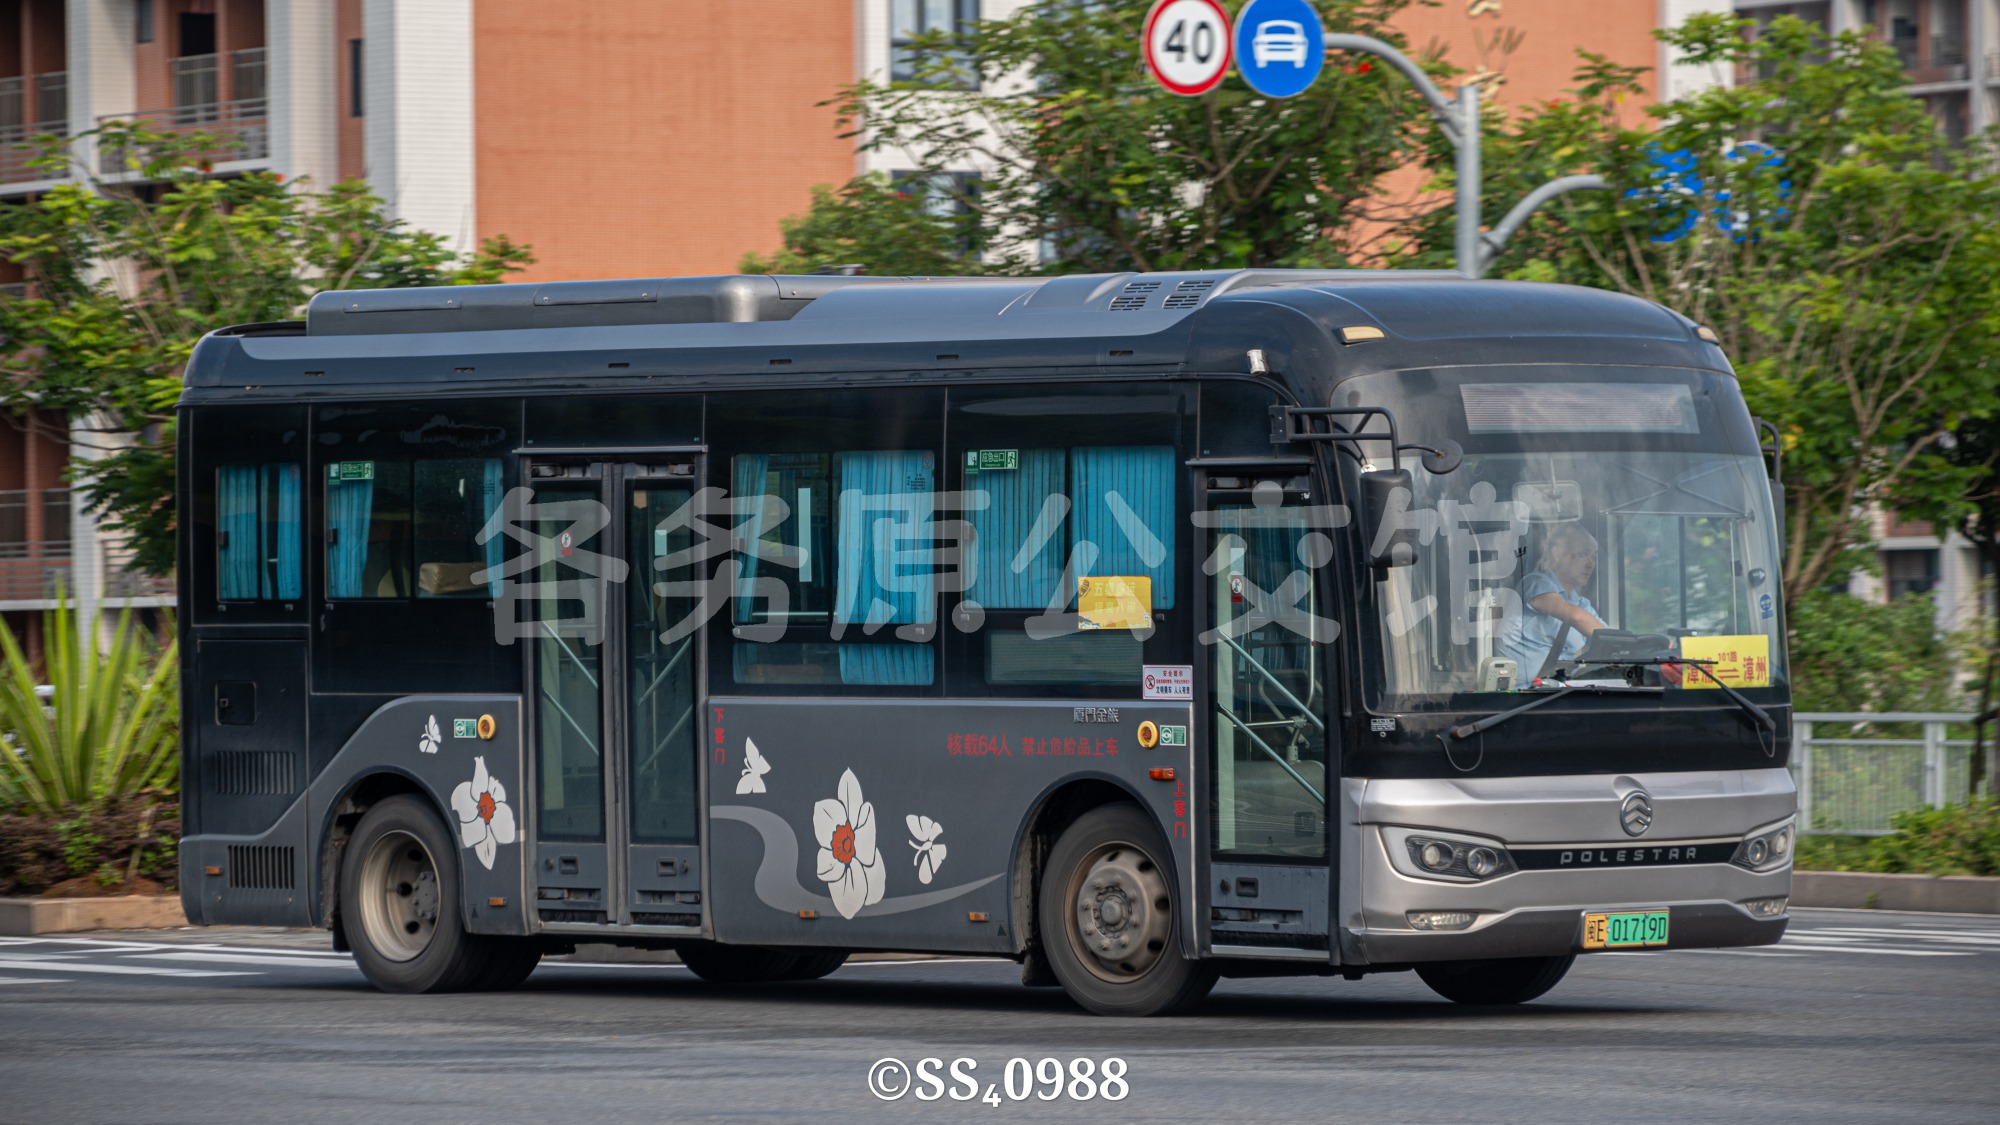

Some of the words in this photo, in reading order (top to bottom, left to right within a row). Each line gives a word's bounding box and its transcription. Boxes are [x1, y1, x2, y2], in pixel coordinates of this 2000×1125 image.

[1163, 19, 1215, 64] 40
[713, 708, 725, 766] 下客门
[947, 732, 1012, 757] 核载64人
[1022, 736, 1119, 757] 禁止危险品上车
[1173, 778, 1187, 839] 上客门
[1560, 847, 1697, 865] POLESTAR
